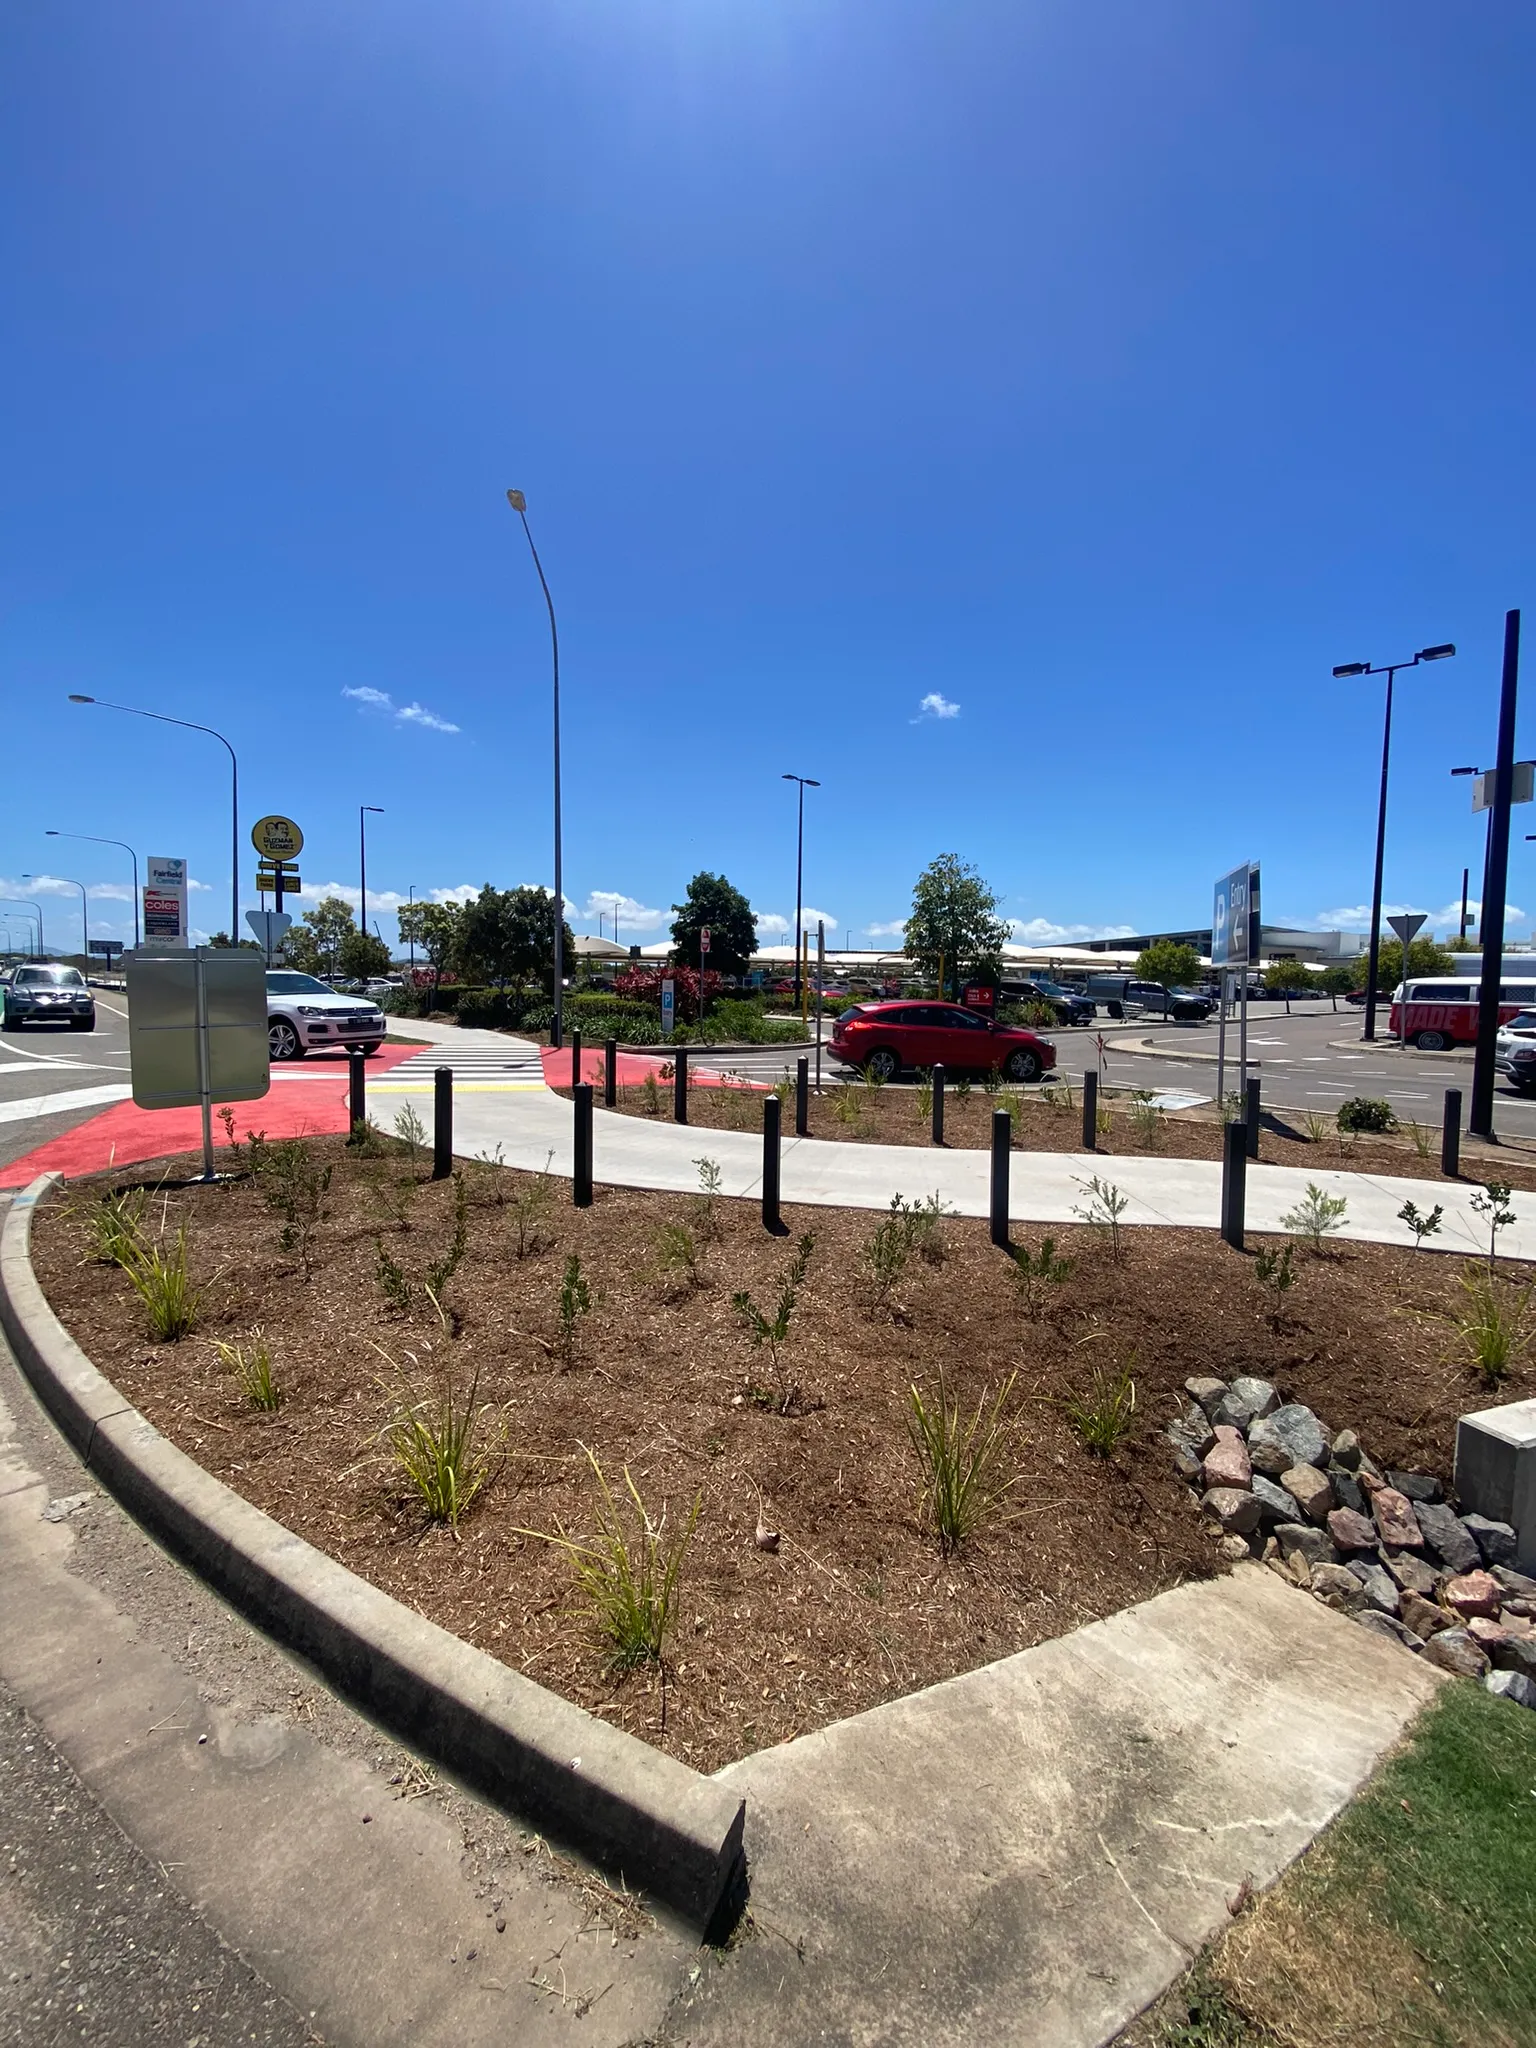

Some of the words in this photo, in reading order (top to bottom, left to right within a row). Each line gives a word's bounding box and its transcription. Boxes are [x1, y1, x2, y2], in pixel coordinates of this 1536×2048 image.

[263, 836, 293, 844] GUZMAN
[153, 869, 183, 878] Fairfield
[155, 877, 182, 885] Central
[1231, 883, 1246, 911] Entry
[145, 900, 179, 910] coles
[1216, 894, 1225, 950] P
[665, 994, 671, 1006] P
[1392, 1006, 1459, 1030] MADE
